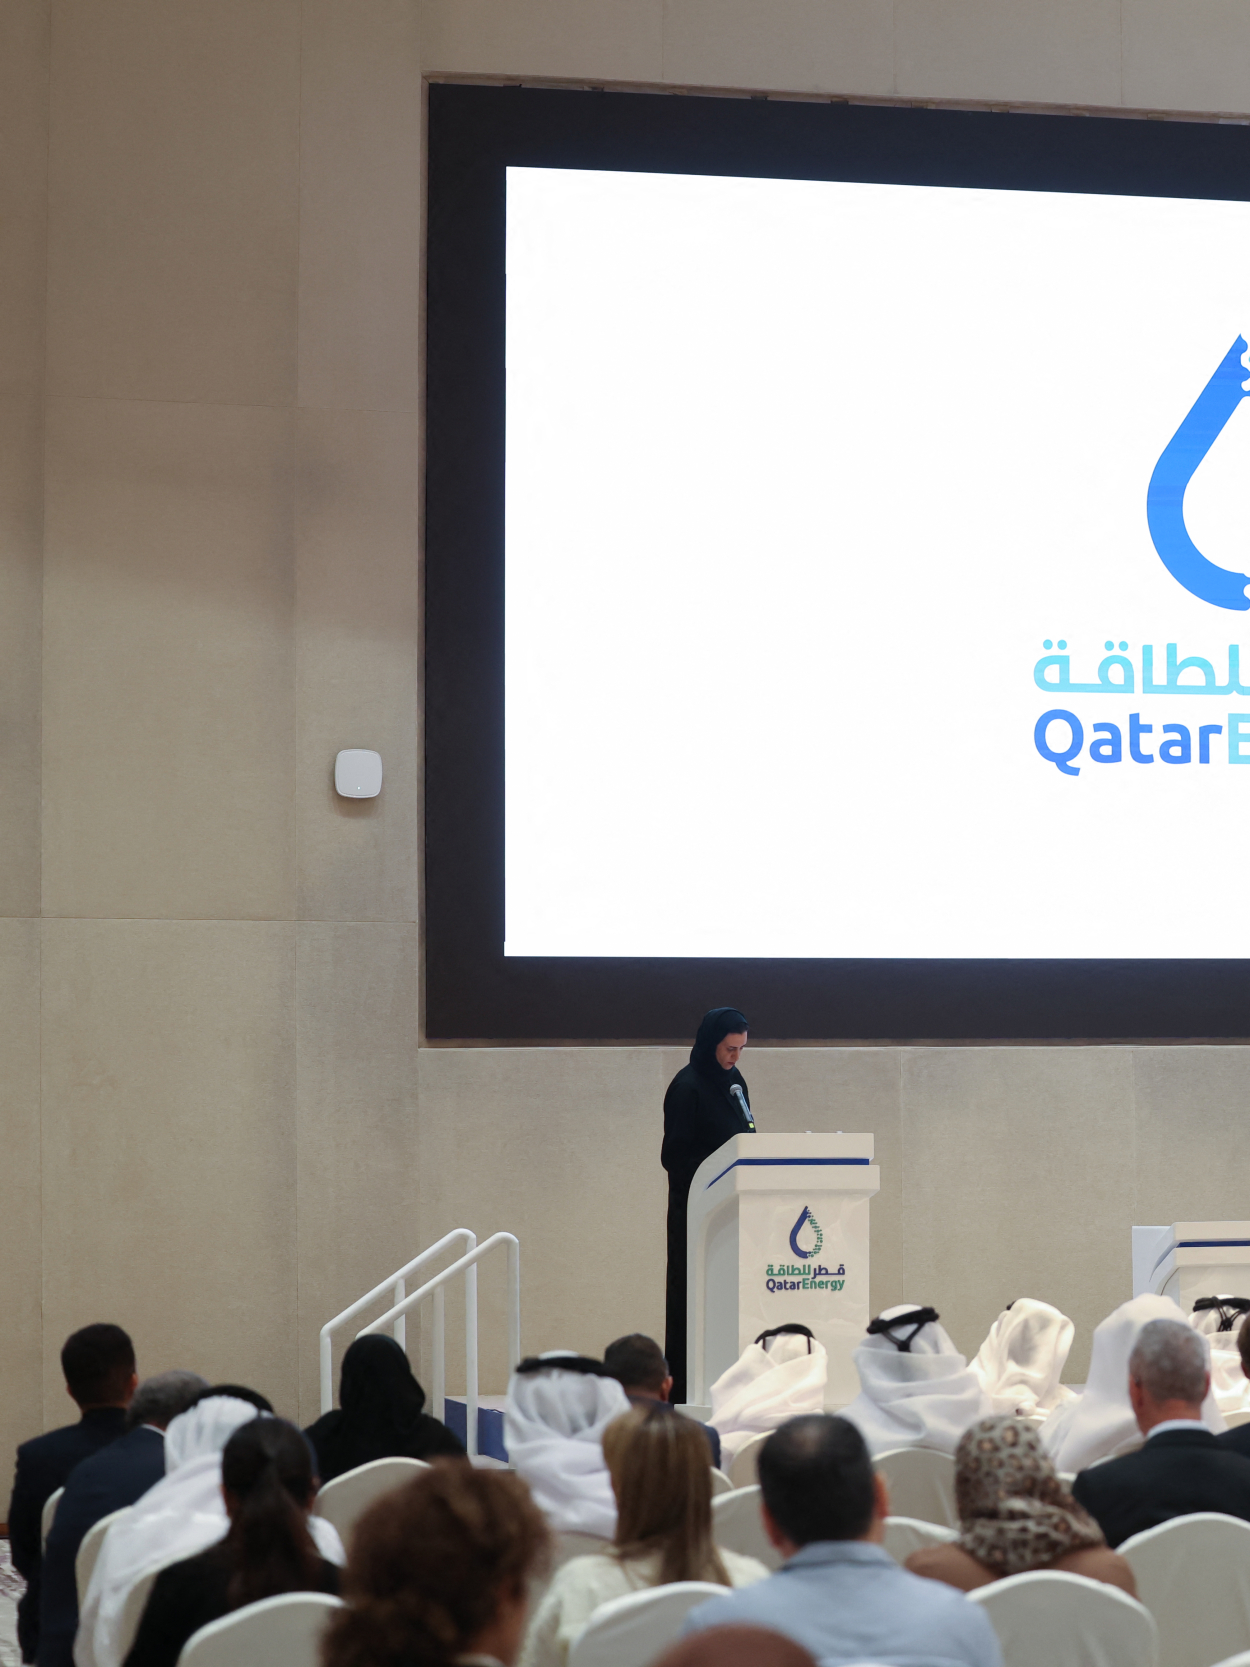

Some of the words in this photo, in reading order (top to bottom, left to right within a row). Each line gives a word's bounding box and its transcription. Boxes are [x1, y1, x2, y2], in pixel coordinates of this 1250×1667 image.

[766, 1264, 811, 1276] للطاقة
[812, 1264, 845, 1279] قطر
[766, 1278, 845, 1293] QatarEnergy
